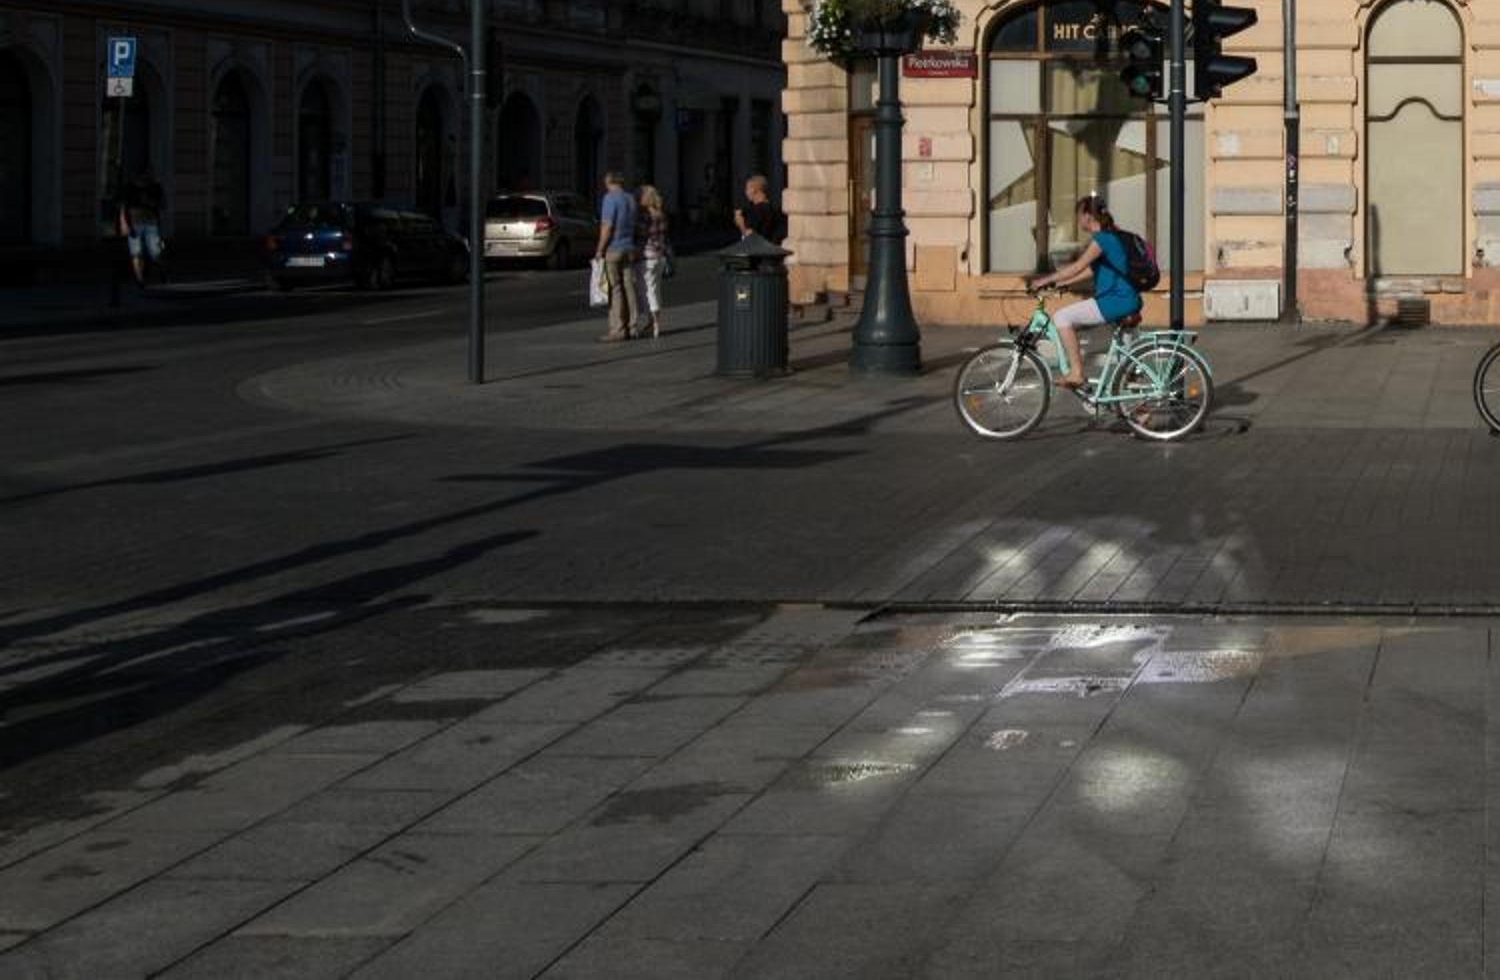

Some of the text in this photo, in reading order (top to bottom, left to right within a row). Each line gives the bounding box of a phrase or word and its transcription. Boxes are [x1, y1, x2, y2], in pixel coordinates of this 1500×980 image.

[1053, 23, 1081, 40] HIT
[114, 41, 131, 66] P
[908, 56, 969, 69] Piotrkowska
